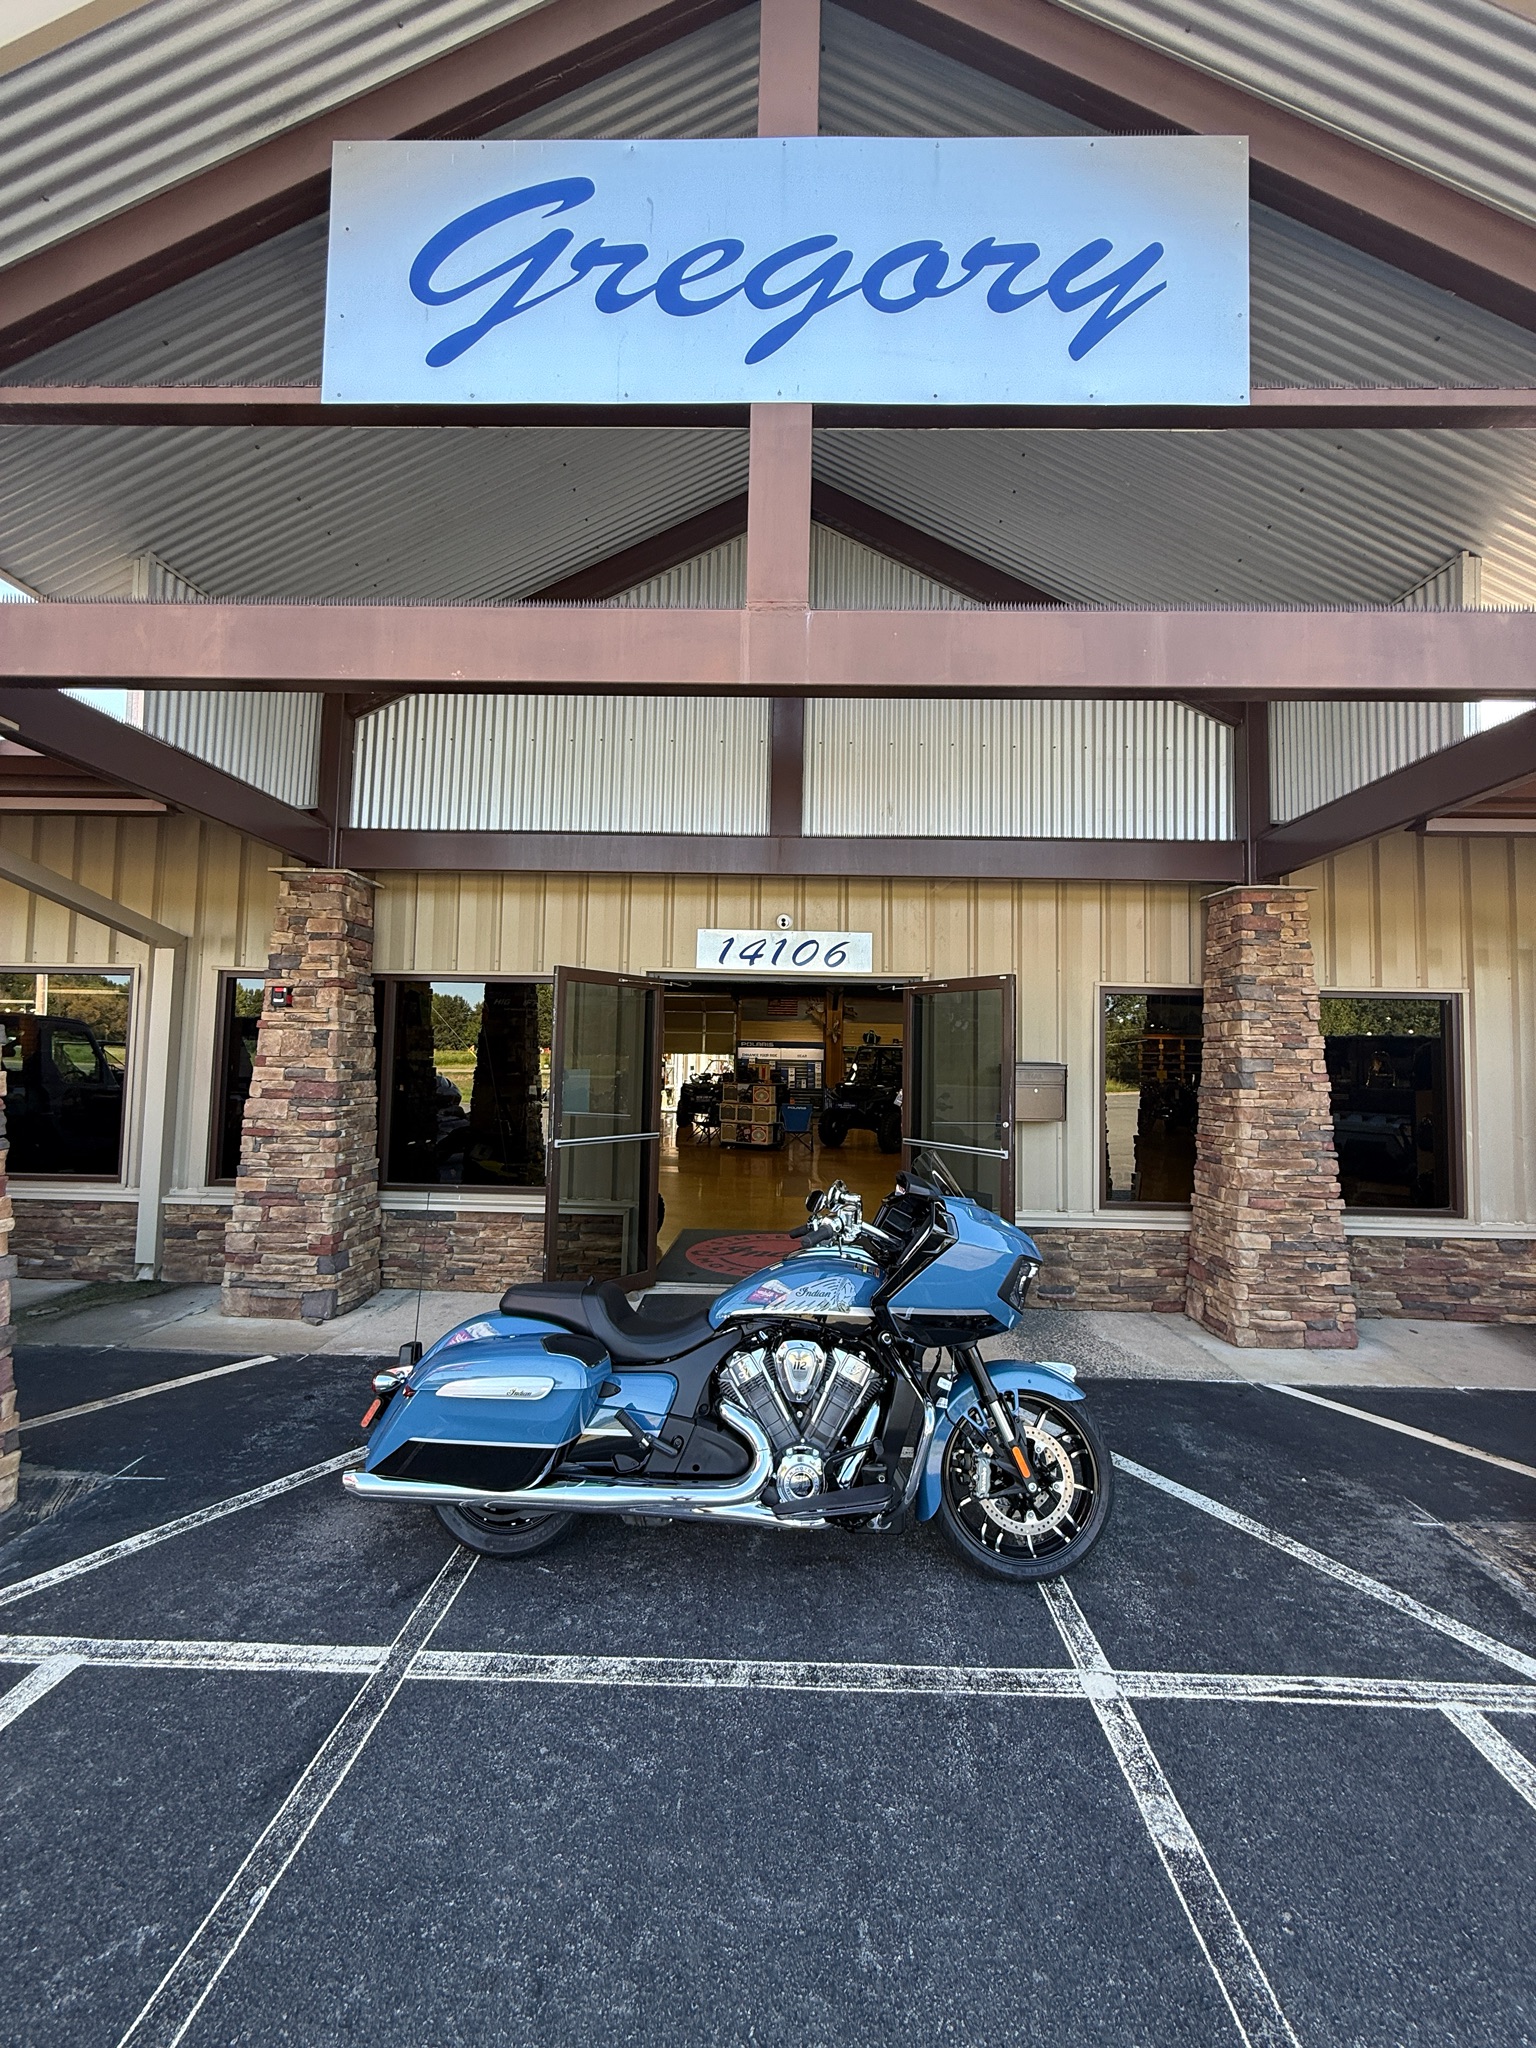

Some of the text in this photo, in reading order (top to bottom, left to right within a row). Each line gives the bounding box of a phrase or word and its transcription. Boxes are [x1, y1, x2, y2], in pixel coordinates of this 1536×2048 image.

[409, 176, 1168, 368] Gregory
[718, 937, 850, 968] 14106
[795, 1286, 831, 1298] Indian
[793, 1361, 807, 1370] 112
[506, 1388, 533, 1396] Indian
